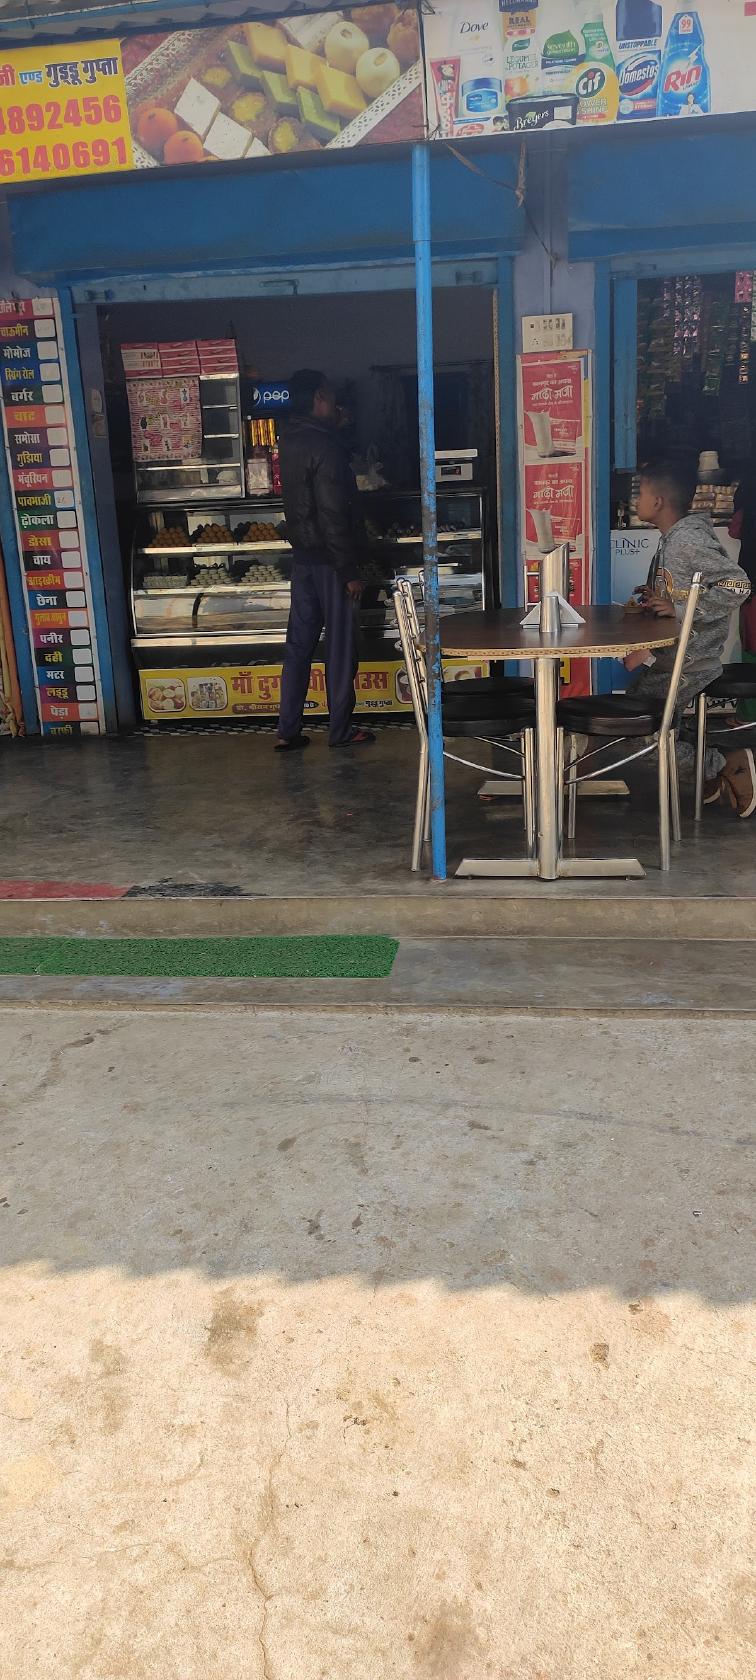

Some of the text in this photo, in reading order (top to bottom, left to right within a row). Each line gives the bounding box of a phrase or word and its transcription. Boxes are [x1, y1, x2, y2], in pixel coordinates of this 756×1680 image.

[459, 21, 489, 33] Dove
[681, 18, 691, 29] 99
[618, 39, 657, 49] UNSTOPPABLE
[81, 57, 118, 83] गुप्ता
[619, 64, 659, 86] Domestos
[578, 71, 601, 95] Cif
[663, 65, 702, 92] Rin
[578, 98, 607, 107] OWER
[513, 110, 549, 131] Breyers
[0, 137, 127, 176] 6140691
[2, 346, 31, 359] मोमोज
[263, 390, 290, 404] pep
[14, 431, 40, 444] समोसा
[27, 534, 52, 547] डोसा
[32, 555, 52, 565] चाय
[36, 593, 57, 606] छेना
[39, 632, 63, 644] पनीर
[44, 651, 63, 663] दही
[46, 670, 65, 680] मटर
[231, 671, 253, 694] माँ
[355, 671, 389, 689] ाउस
[46, 687, 69, 699] लड्डू
